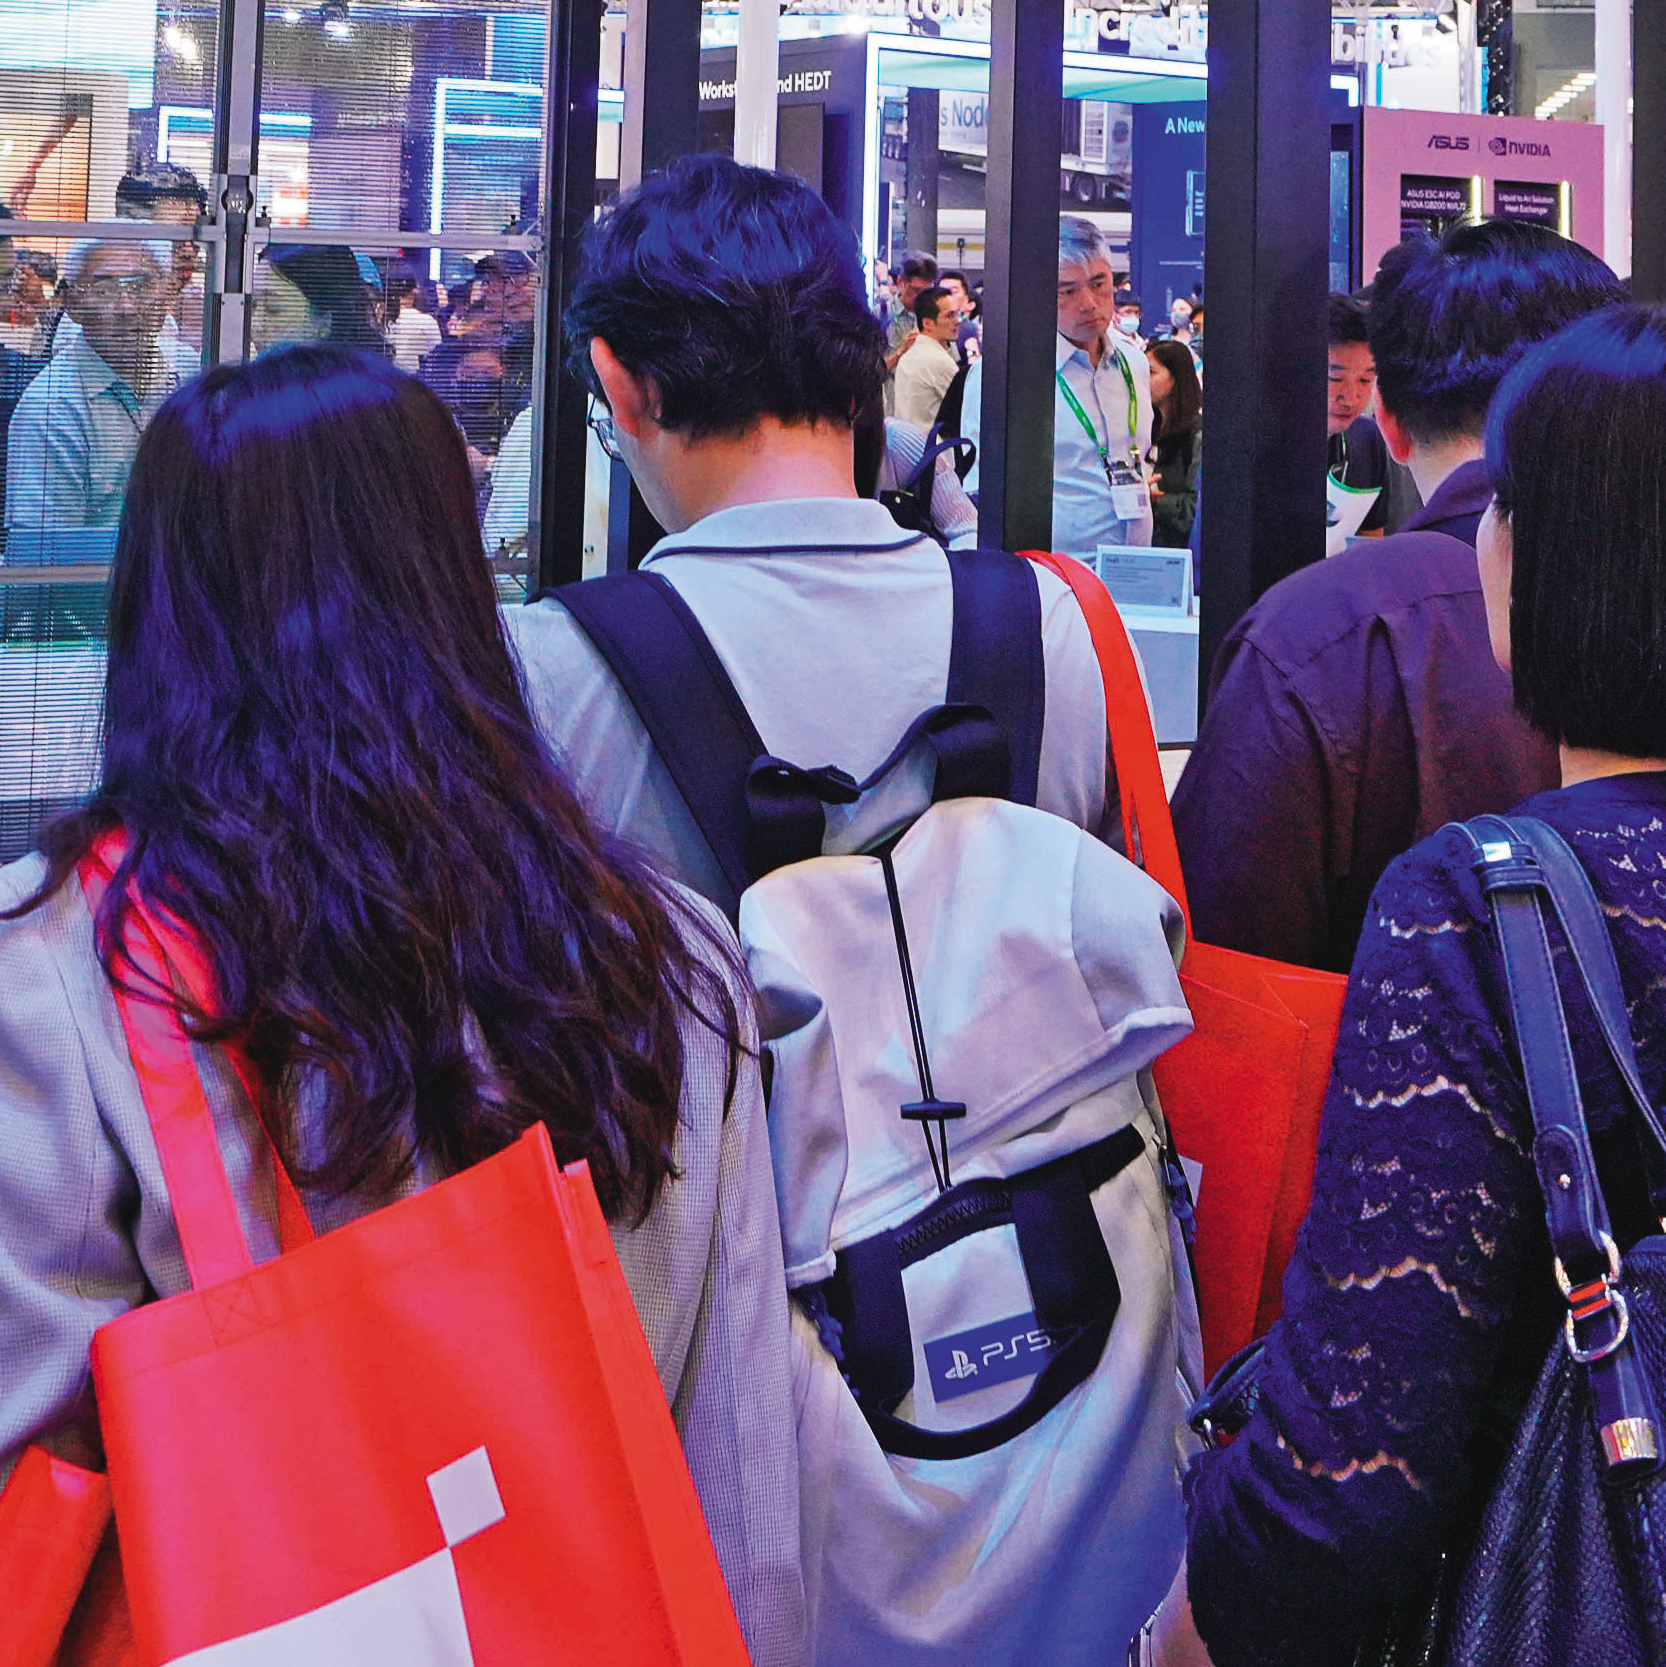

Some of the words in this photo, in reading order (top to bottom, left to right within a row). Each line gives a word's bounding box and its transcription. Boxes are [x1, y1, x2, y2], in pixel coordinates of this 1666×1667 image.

[776, 74, 792, 94] nd
[794, 70, 832, 92] HEDT
[1165, 117, 1176, 134] A
[1177, 116, 1206, 133] New
[1427, 134, 1470, 151] ASUS
[1508, 141, 1552, 157] NVIDIA
[980, 1328, 1052, 1367] PS5
